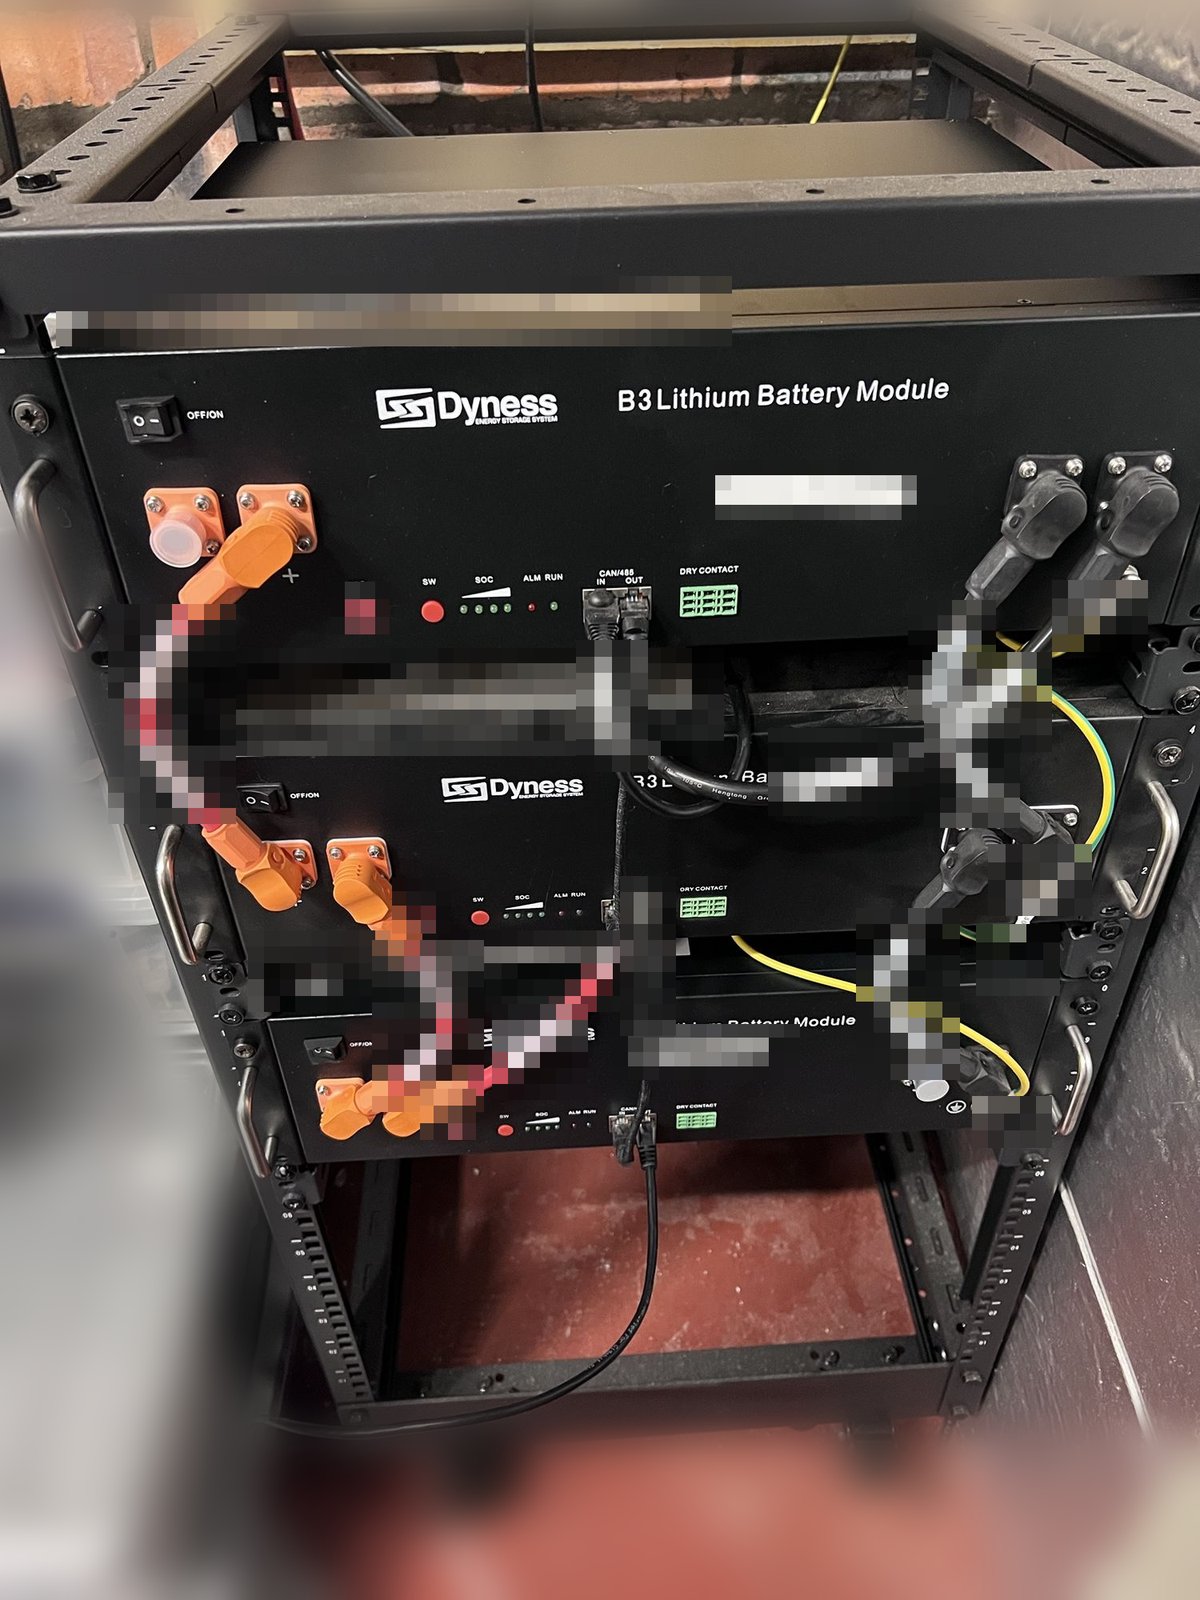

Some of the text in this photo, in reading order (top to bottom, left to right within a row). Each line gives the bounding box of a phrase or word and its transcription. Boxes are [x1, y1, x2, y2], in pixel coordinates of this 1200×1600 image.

[618, 378, 949, 411] B3 Lithium Battery Module
[437, 390, 558, 426] Dyness
[186, 410, 224, 420] OFF/ON
[502, 416, 531, 424] STORAGE
[532, 415, 558, 423] SYSTEM
[599, 569, 635, 577] CAN/485
[698, 565, 739, 575] CONTACT
[422, 578, 436, 586] SW
[474, 576, 494, 584] SOC
[523, 573, 563, 582] ALM RUN
[625, 576, 643, 584] OUT
[490, 778, 584, 800] Dyness
[794, 1015, 856, 1028] Module
